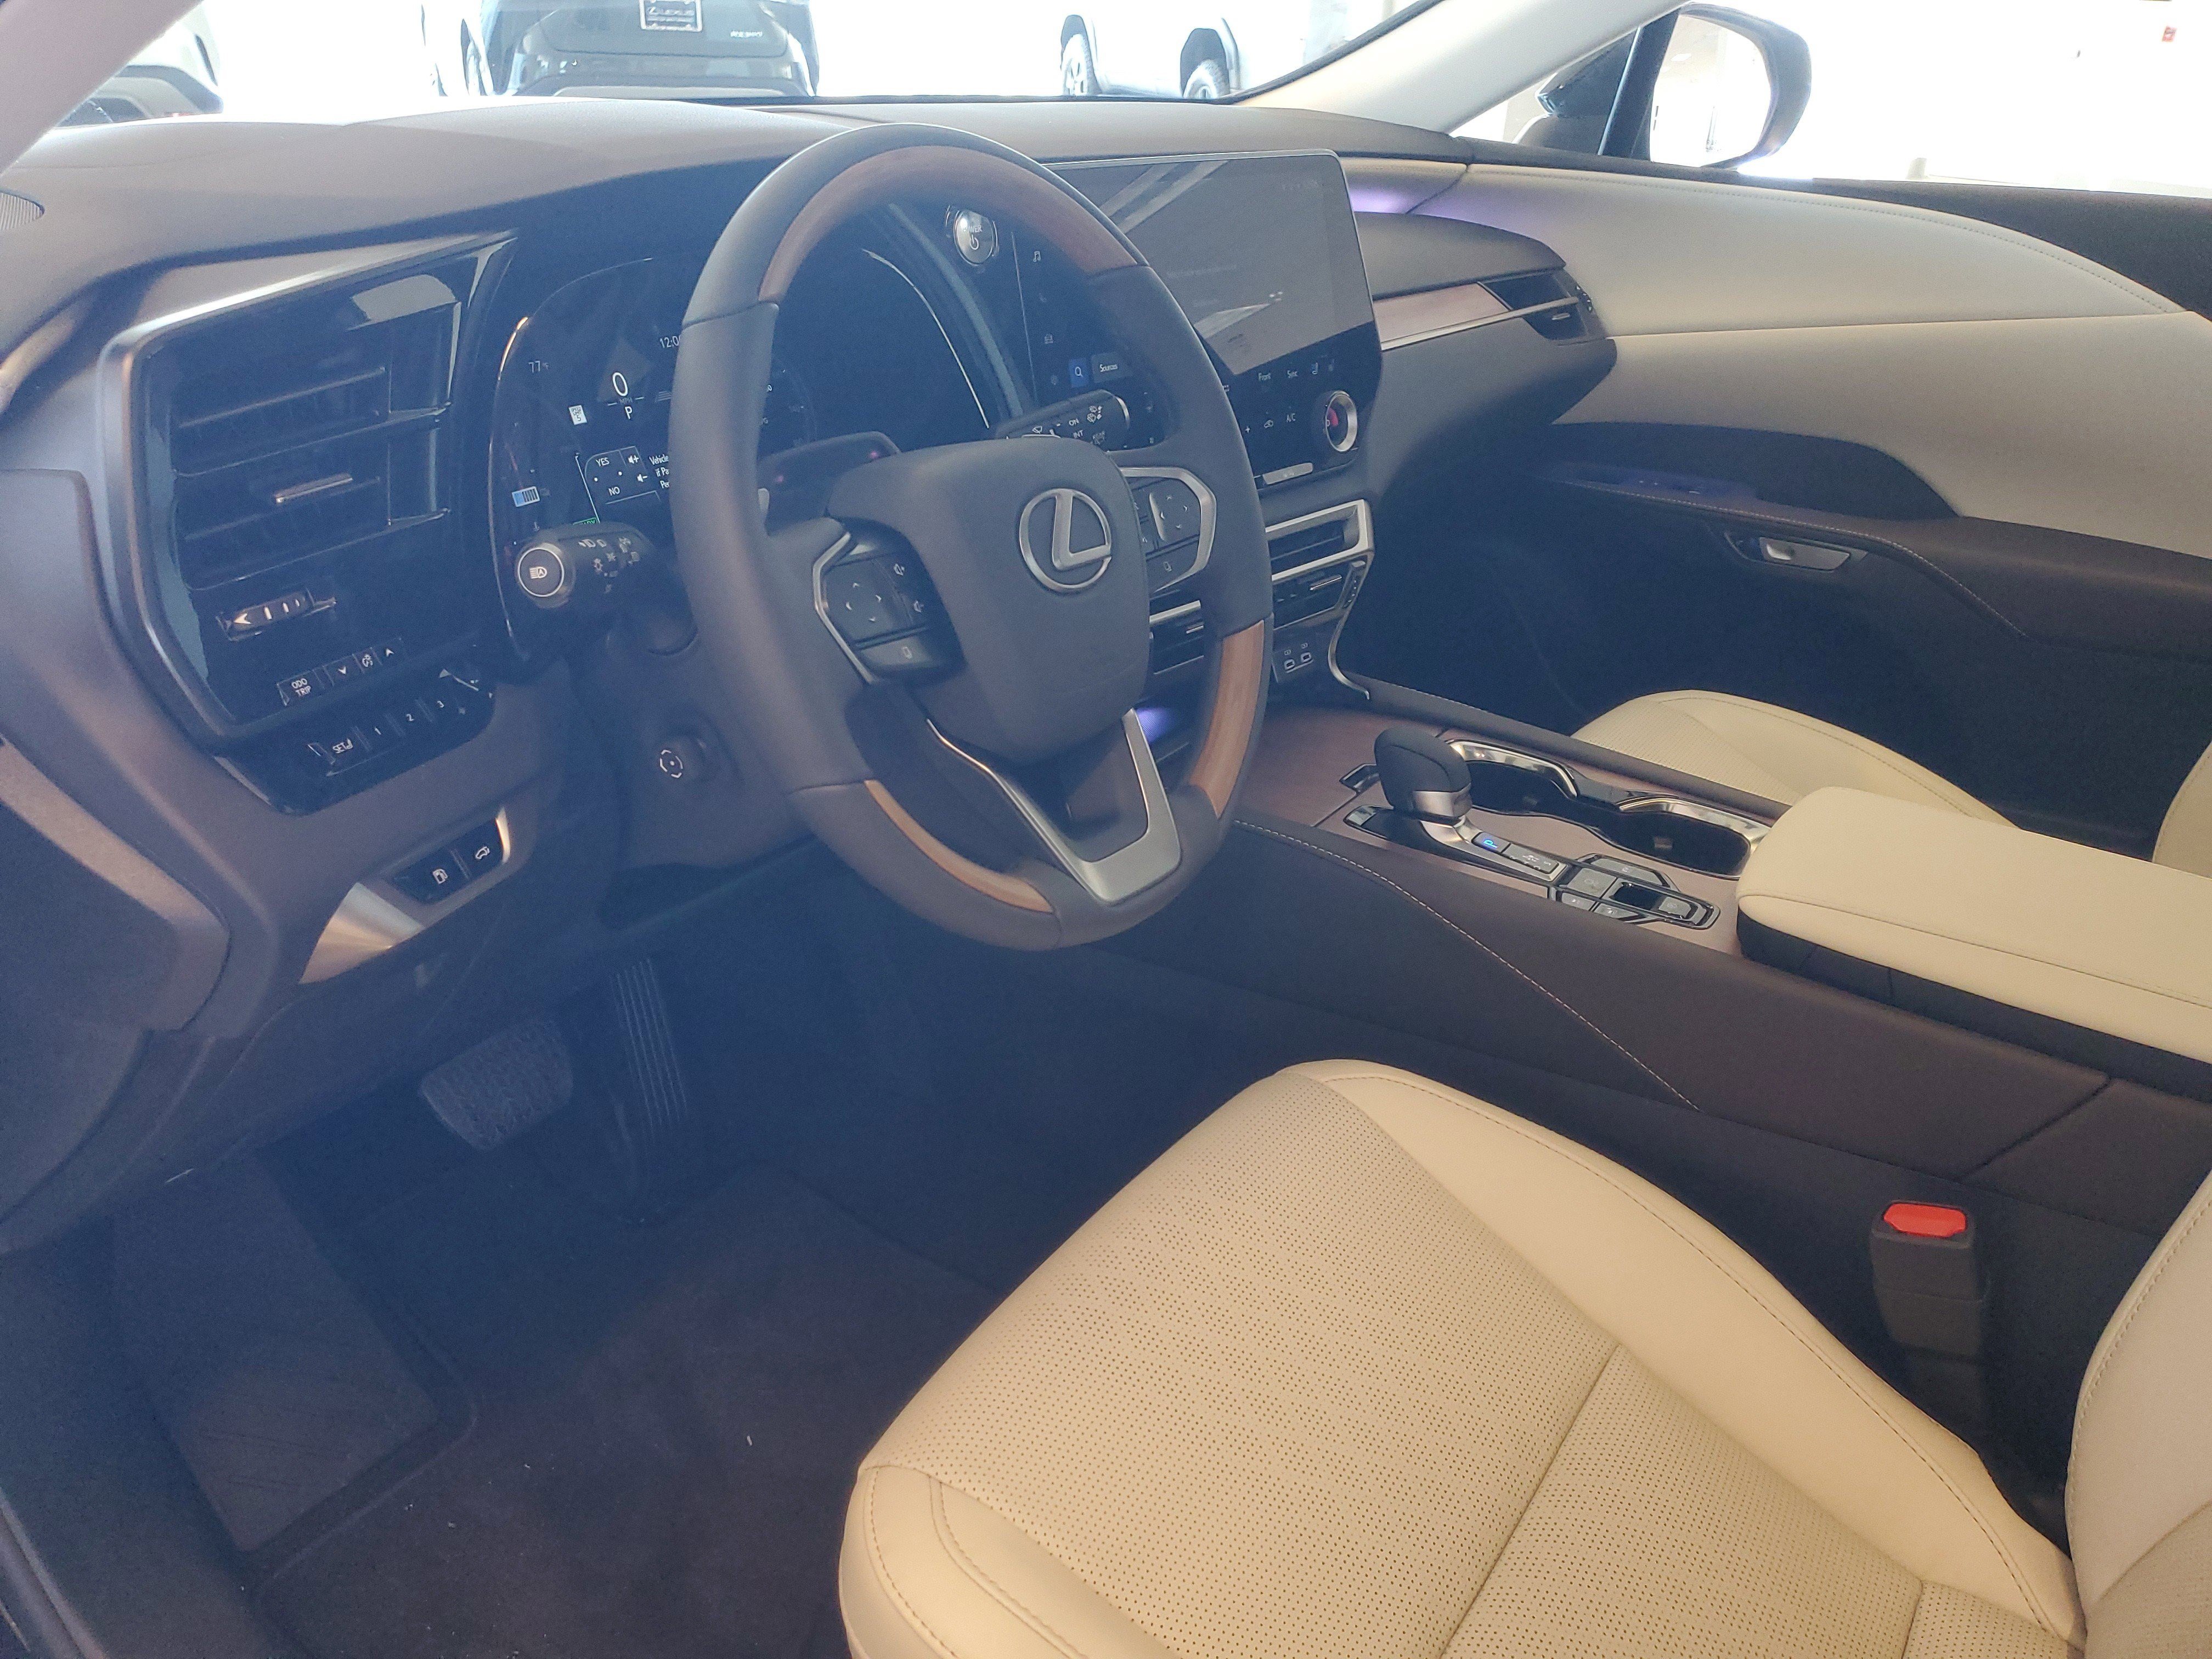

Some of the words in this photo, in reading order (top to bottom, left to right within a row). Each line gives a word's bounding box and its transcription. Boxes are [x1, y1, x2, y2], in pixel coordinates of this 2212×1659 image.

[962, 224, 983, 233] PWER
[659, 335, 680, 348] 12:0
[612, 371, 628, 396] 0
[624, 405, 633, 420] P
[1069, 418, 1079, 426] ON
[1073, 430, 1084, 438] INT
[595, 457, 610, 467] YES
[648, 454, 669, 465] Vehicle
[608, 487, 620, 496] NO
[291, 678, 307, 689] ODO
[295, 685, 312, 697] TRIP
[332, 742, 347, 754] SET
[374, 727, 381, 735] 1
[405, 713, 414, 721] 2
